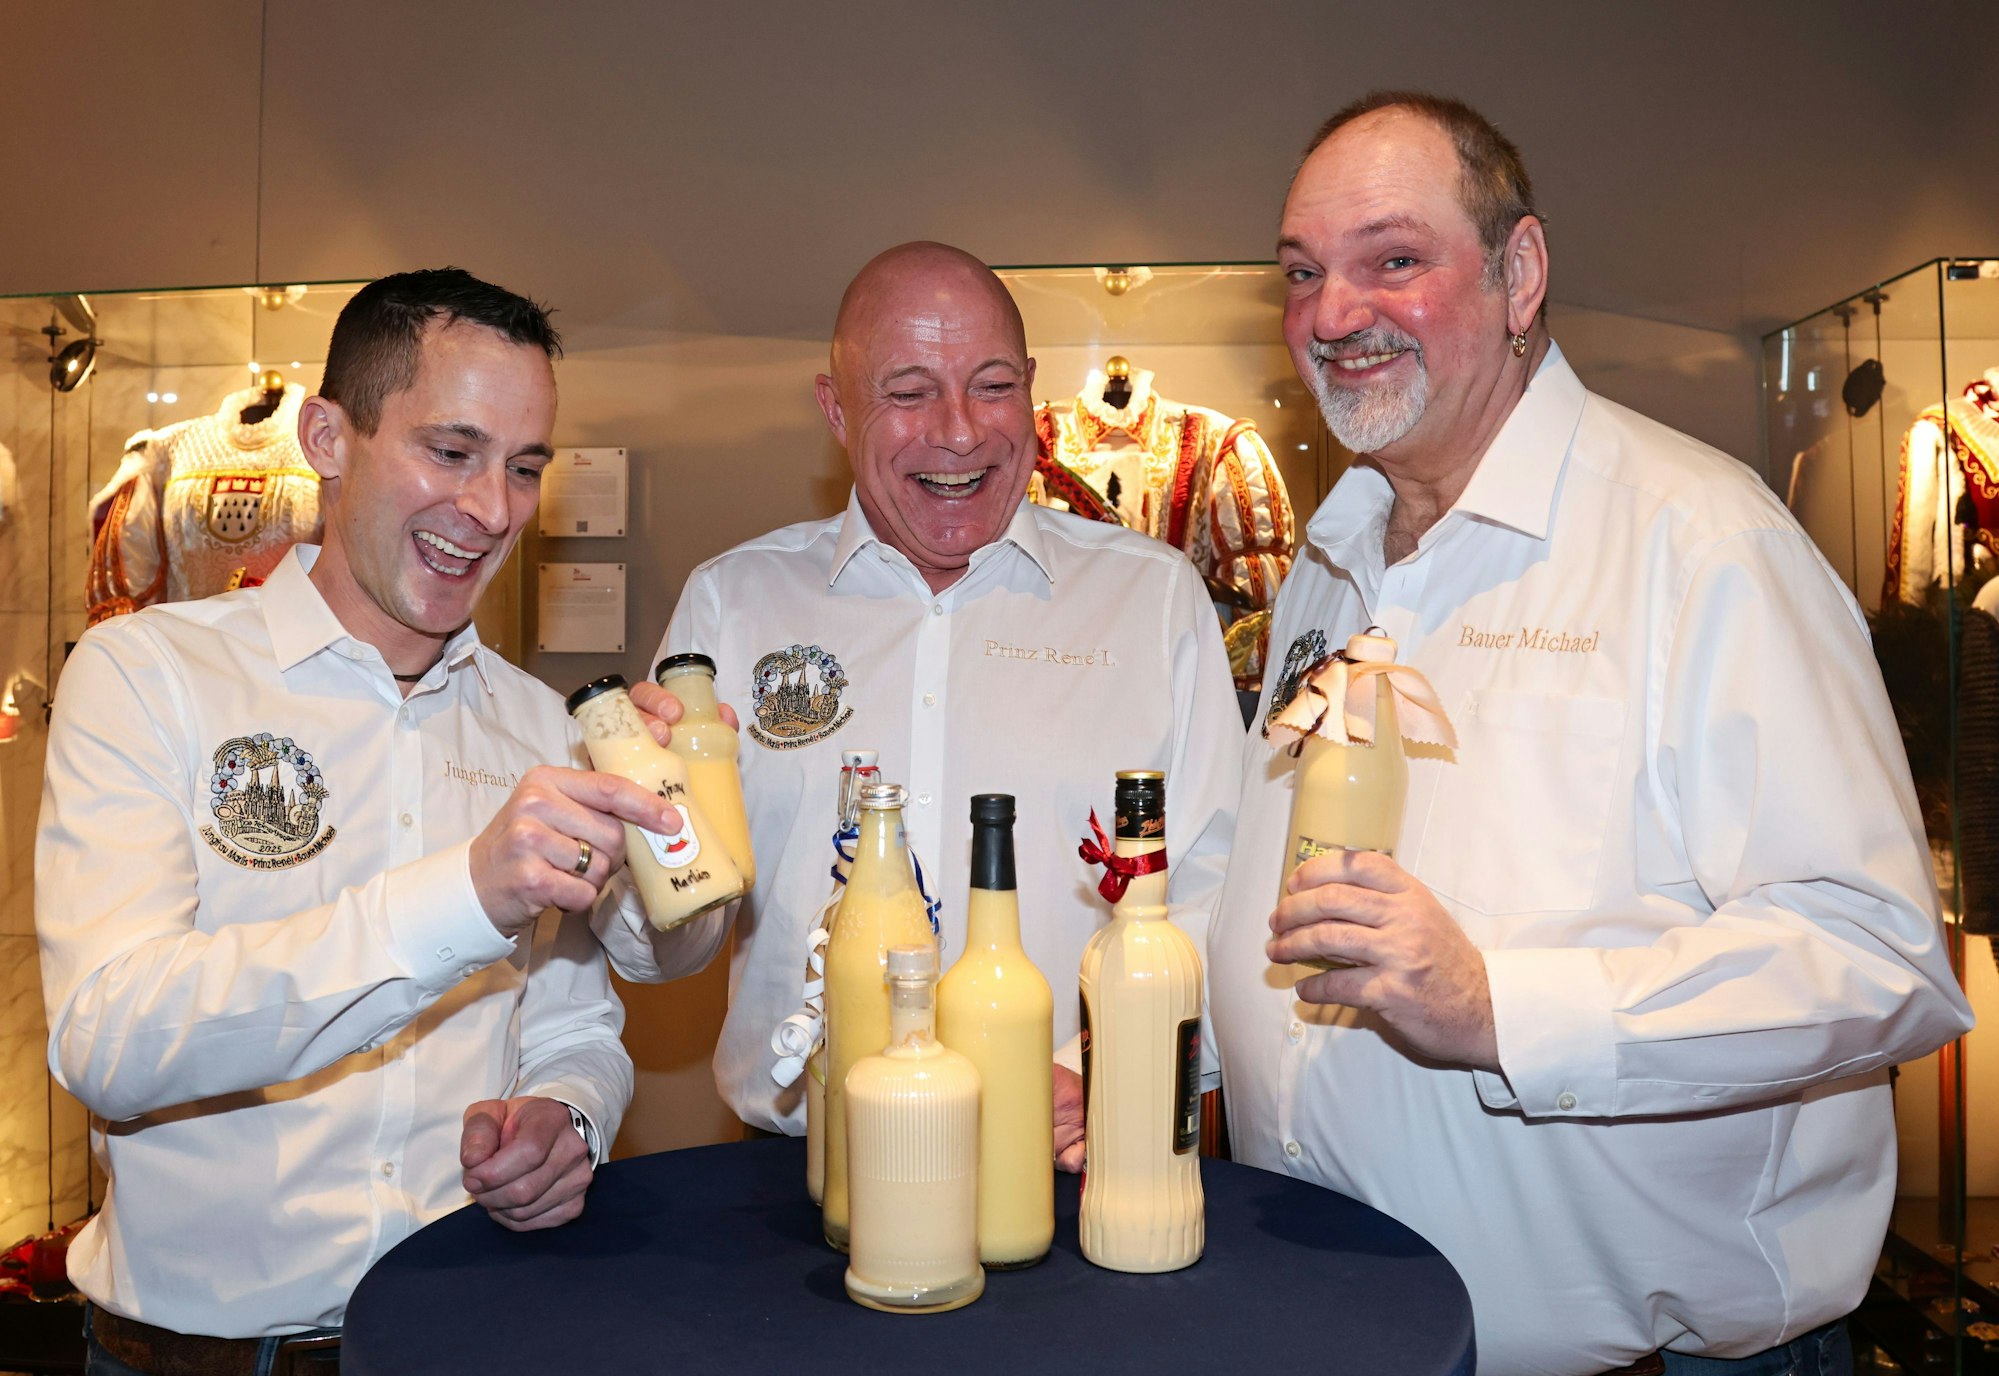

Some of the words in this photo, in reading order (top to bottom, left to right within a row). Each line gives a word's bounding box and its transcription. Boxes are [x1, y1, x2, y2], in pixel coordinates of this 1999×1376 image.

[984, 639, 1038, 660] Prinz
[1043, 646, 1097, 666] René
[1457, 625, 1515, 649] Bauer
[1516, 626, 1600, 653] Michael
[444, 760, 508, 788] Jungfrau
[656, 778, 686, 801] gfrau
[202, 826, 229, 854] Jungfrau
[252, 858, 272, 869] Prinz
